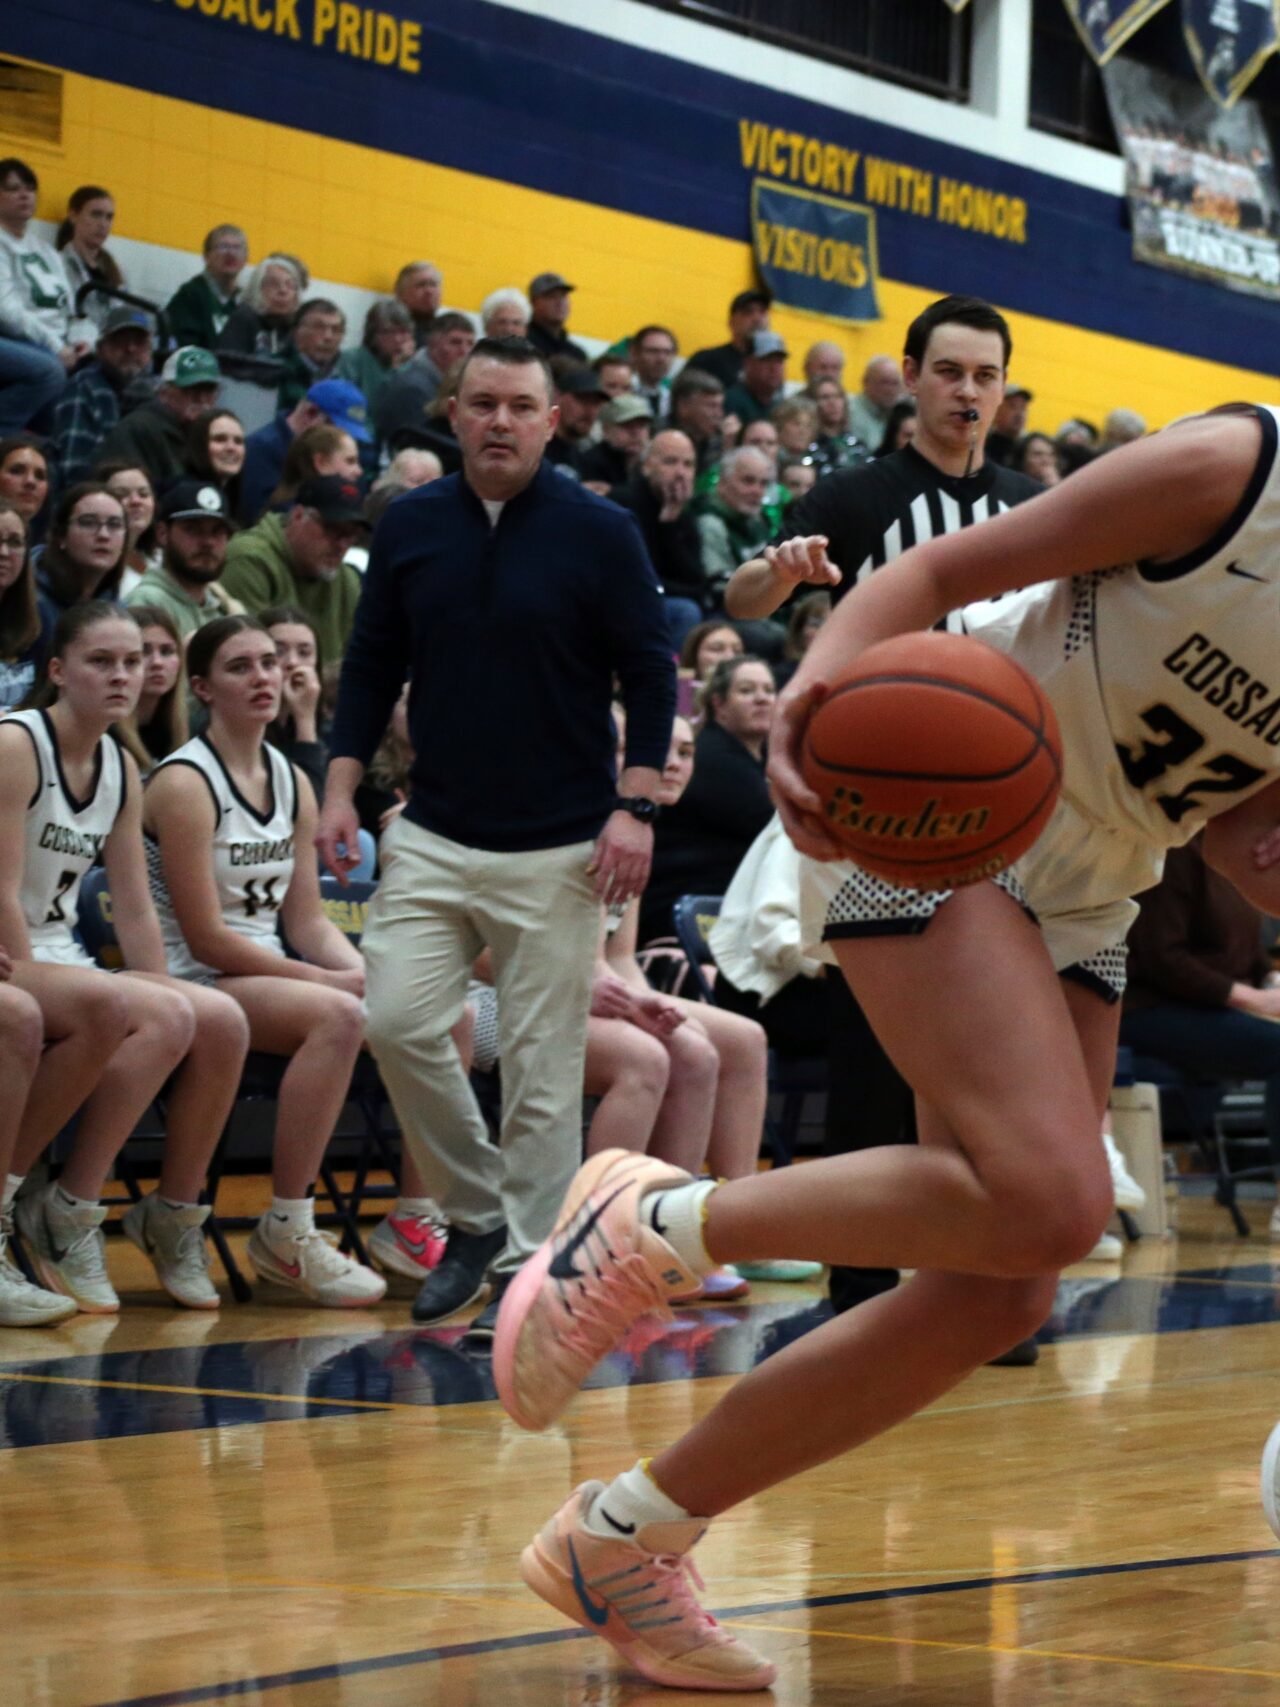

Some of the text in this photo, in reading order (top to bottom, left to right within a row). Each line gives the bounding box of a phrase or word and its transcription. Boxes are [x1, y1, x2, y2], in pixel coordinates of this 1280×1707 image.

[312, 0, 422, 73] PRIDE
[739, 118, 1028, 244] VICTORY WITH HONOR
[756, 219, 868, 289] VISITORS
[1115, 702, 1268, 824] 32
